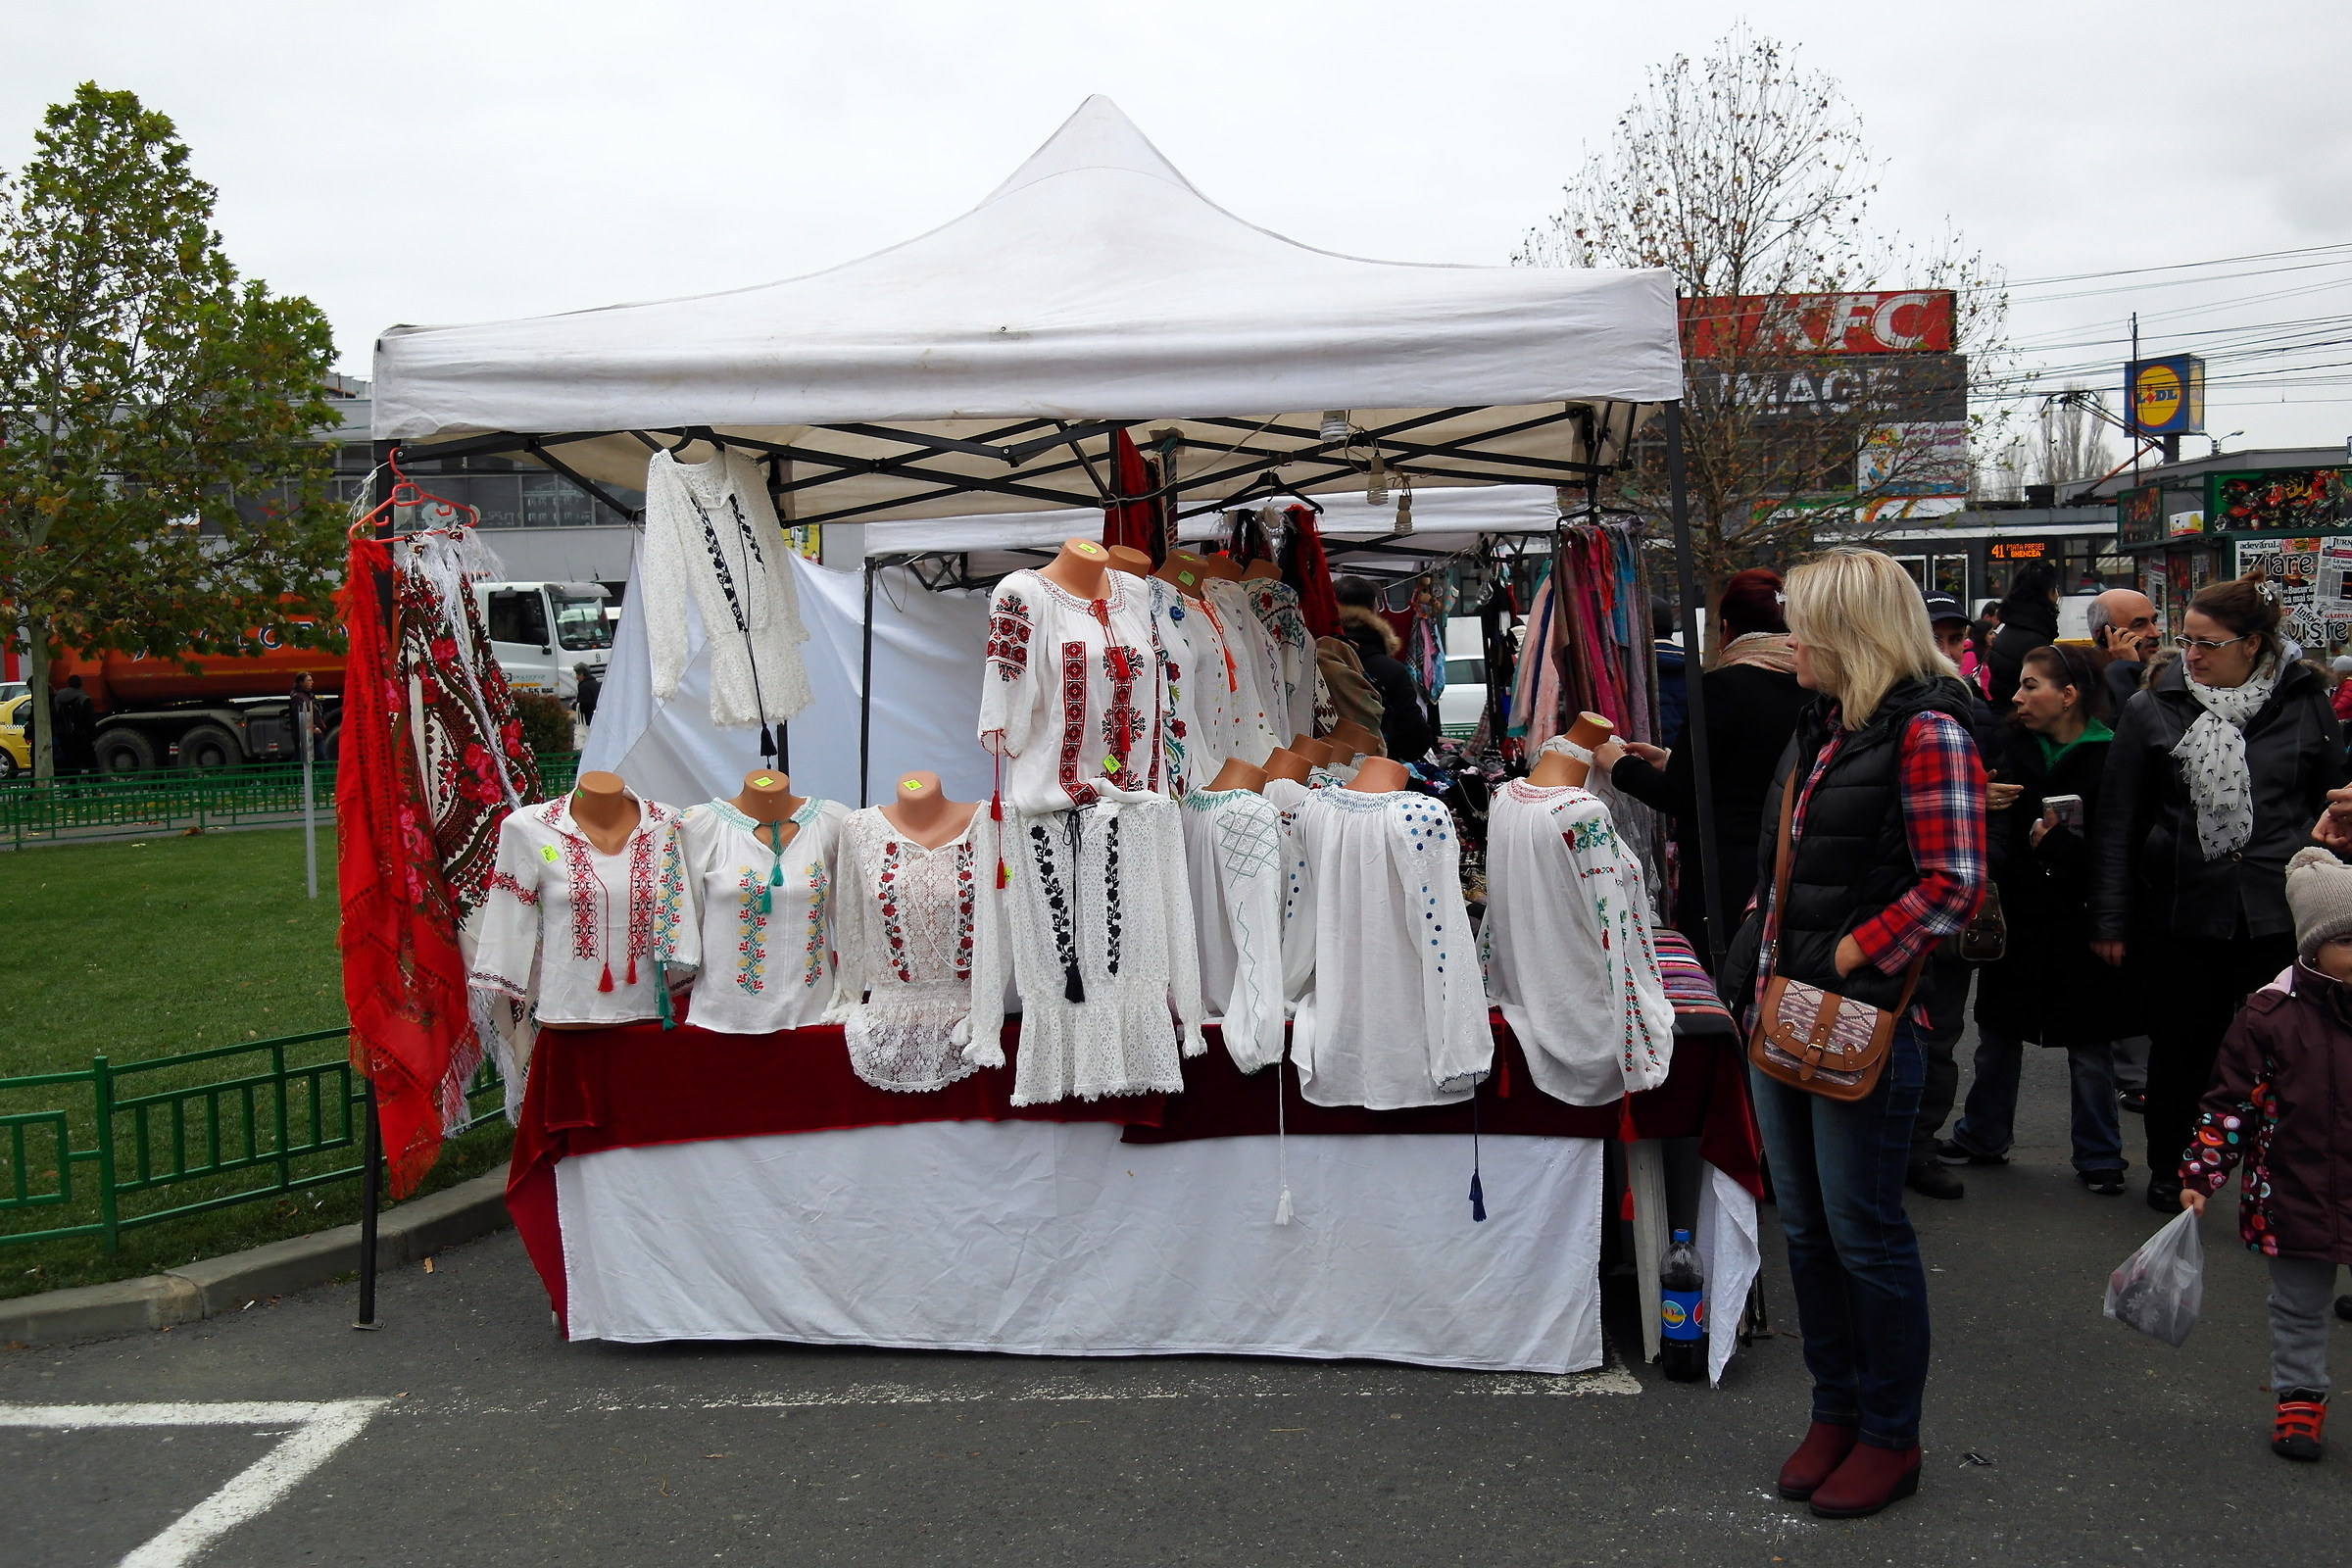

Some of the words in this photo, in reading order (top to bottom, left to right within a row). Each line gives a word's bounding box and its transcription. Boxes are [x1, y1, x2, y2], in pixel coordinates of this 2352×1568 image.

[1751, 293, 1930, 351] KFC
[1991, 544, 2005, 559] 41
[2010, 550, 2041, 559] GHENCEA
[2247, 552, 2313, 576] Ziare
[2285, 618, 2348, 641] viste
